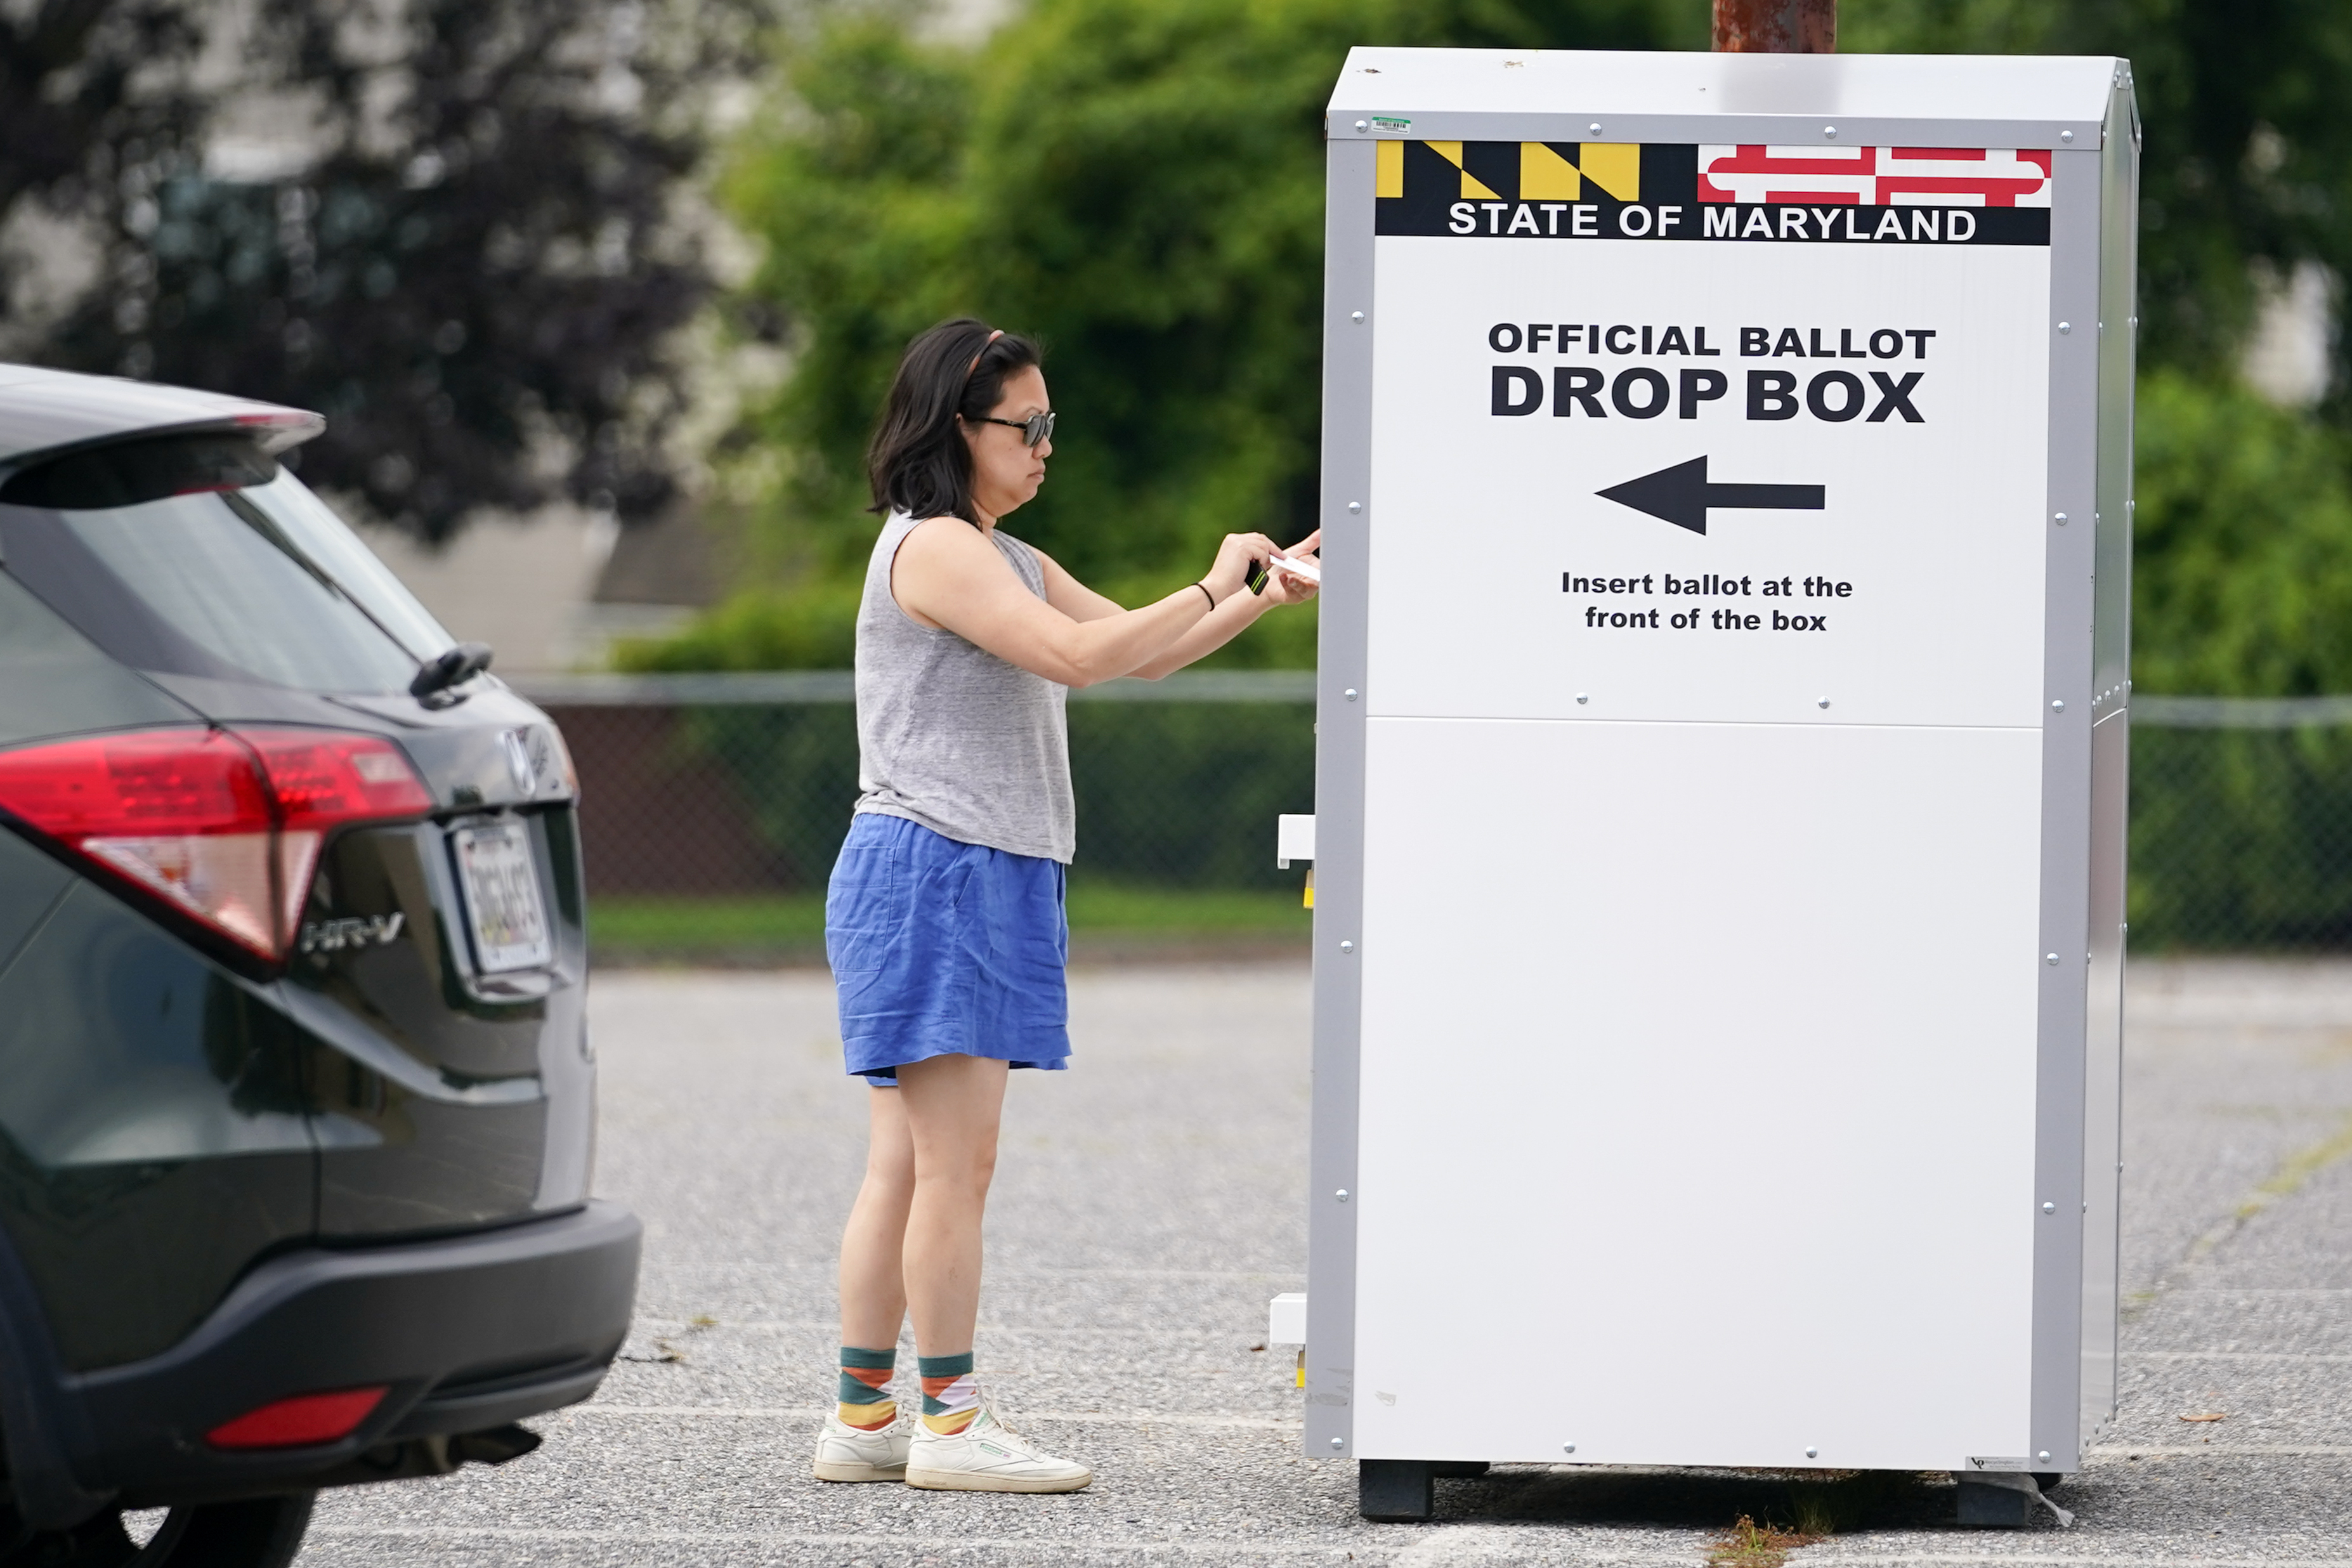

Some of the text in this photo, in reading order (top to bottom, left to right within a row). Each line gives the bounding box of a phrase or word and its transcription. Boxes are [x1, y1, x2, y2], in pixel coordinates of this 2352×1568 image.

[1449, 202, 1976, 241] STATE OF MARYLAND
[1489, 323, 1937, 359] OFFICIAL BALLOT
[1491, 365, 1926, 423] DROP BOX
[1562, 572, 1853, 598] Insert ballot at the
[1585, 606, 1827, 631] front of the box
[301, 911, 405, 951] HR-V
